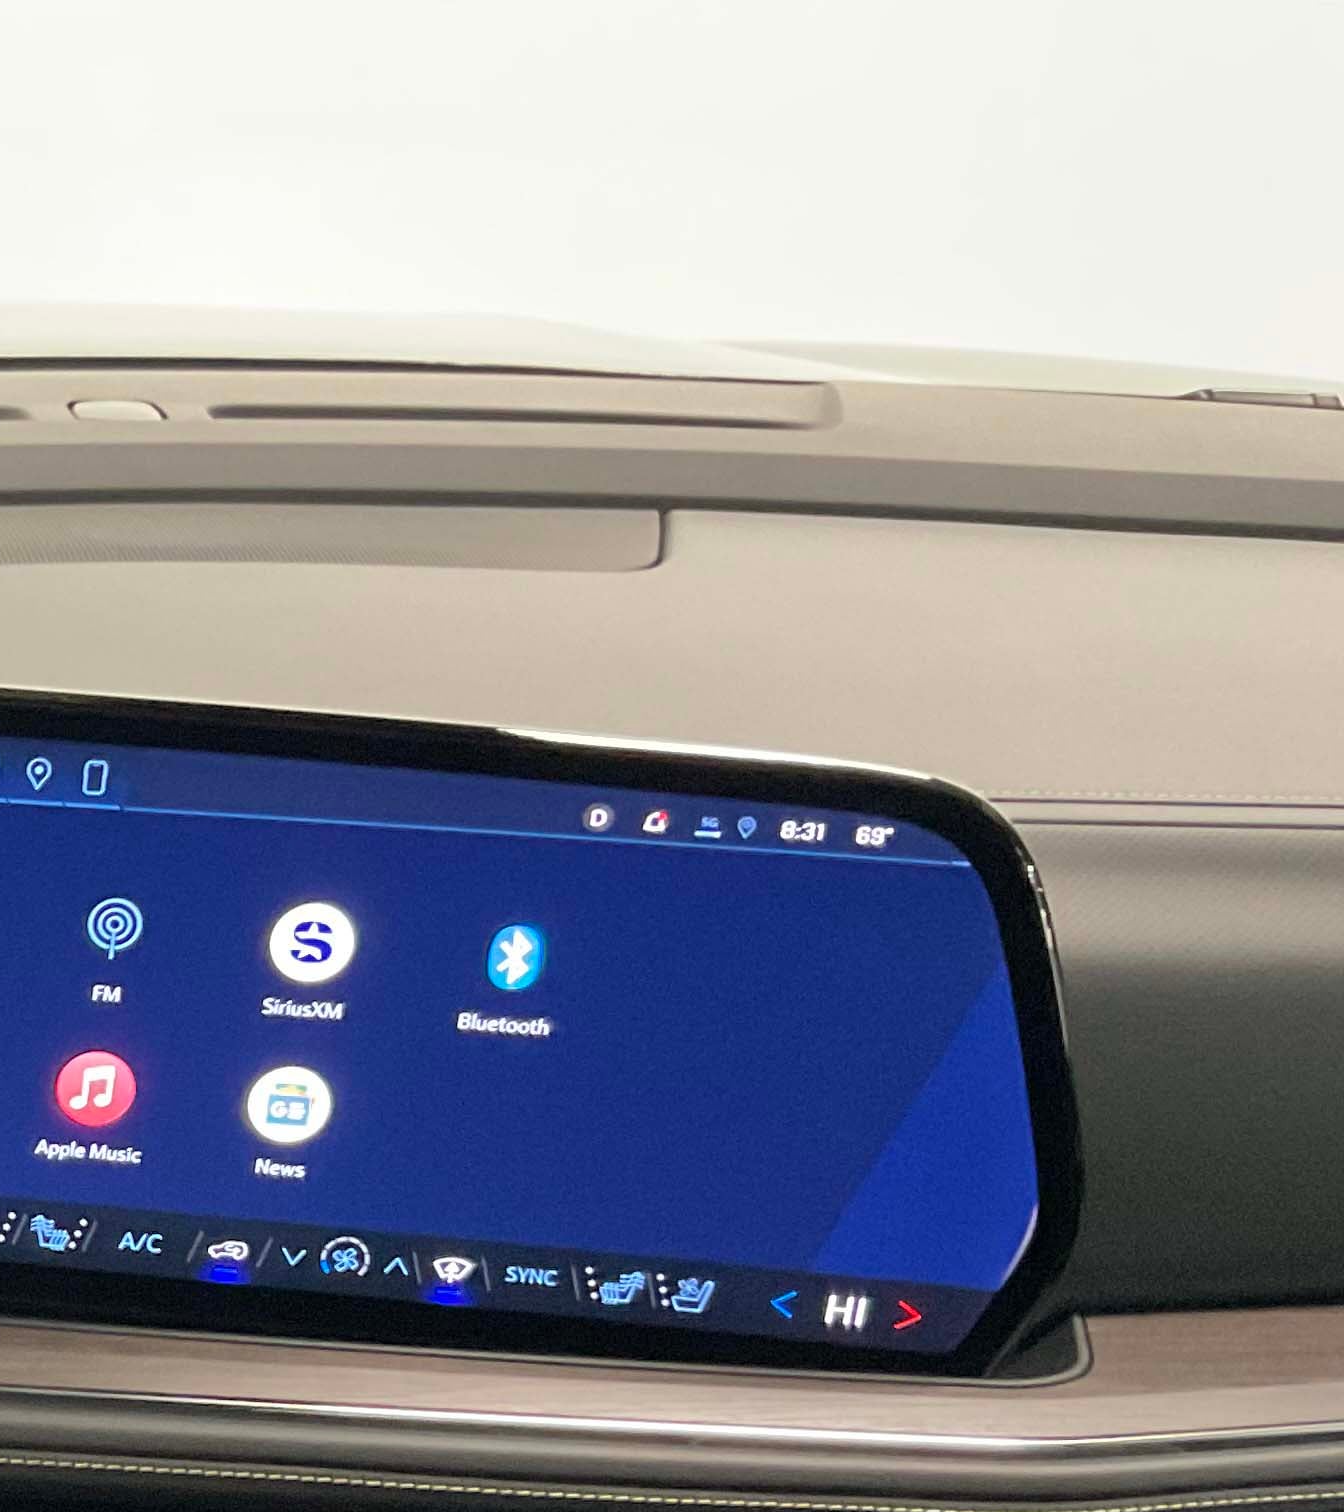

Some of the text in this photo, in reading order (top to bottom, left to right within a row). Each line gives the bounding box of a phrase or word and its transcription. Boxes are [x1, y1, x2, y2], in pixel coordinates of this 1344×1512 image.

[779, 819, 825, 842] 8:31
[91, 984, 122, 1004] FM
[261, 997, 344, 1020] SiriusXM
[457, 1012, 551, 1036] Bluetooth
[34, 1138, 142, 1165] Apple Music
[254, 1157, 306, 1178] News
[118, 1231, 162, 1254] A/C
[505, 1264, 557, 1287] SYNC
[824, 1294, 867, 1328] HI
